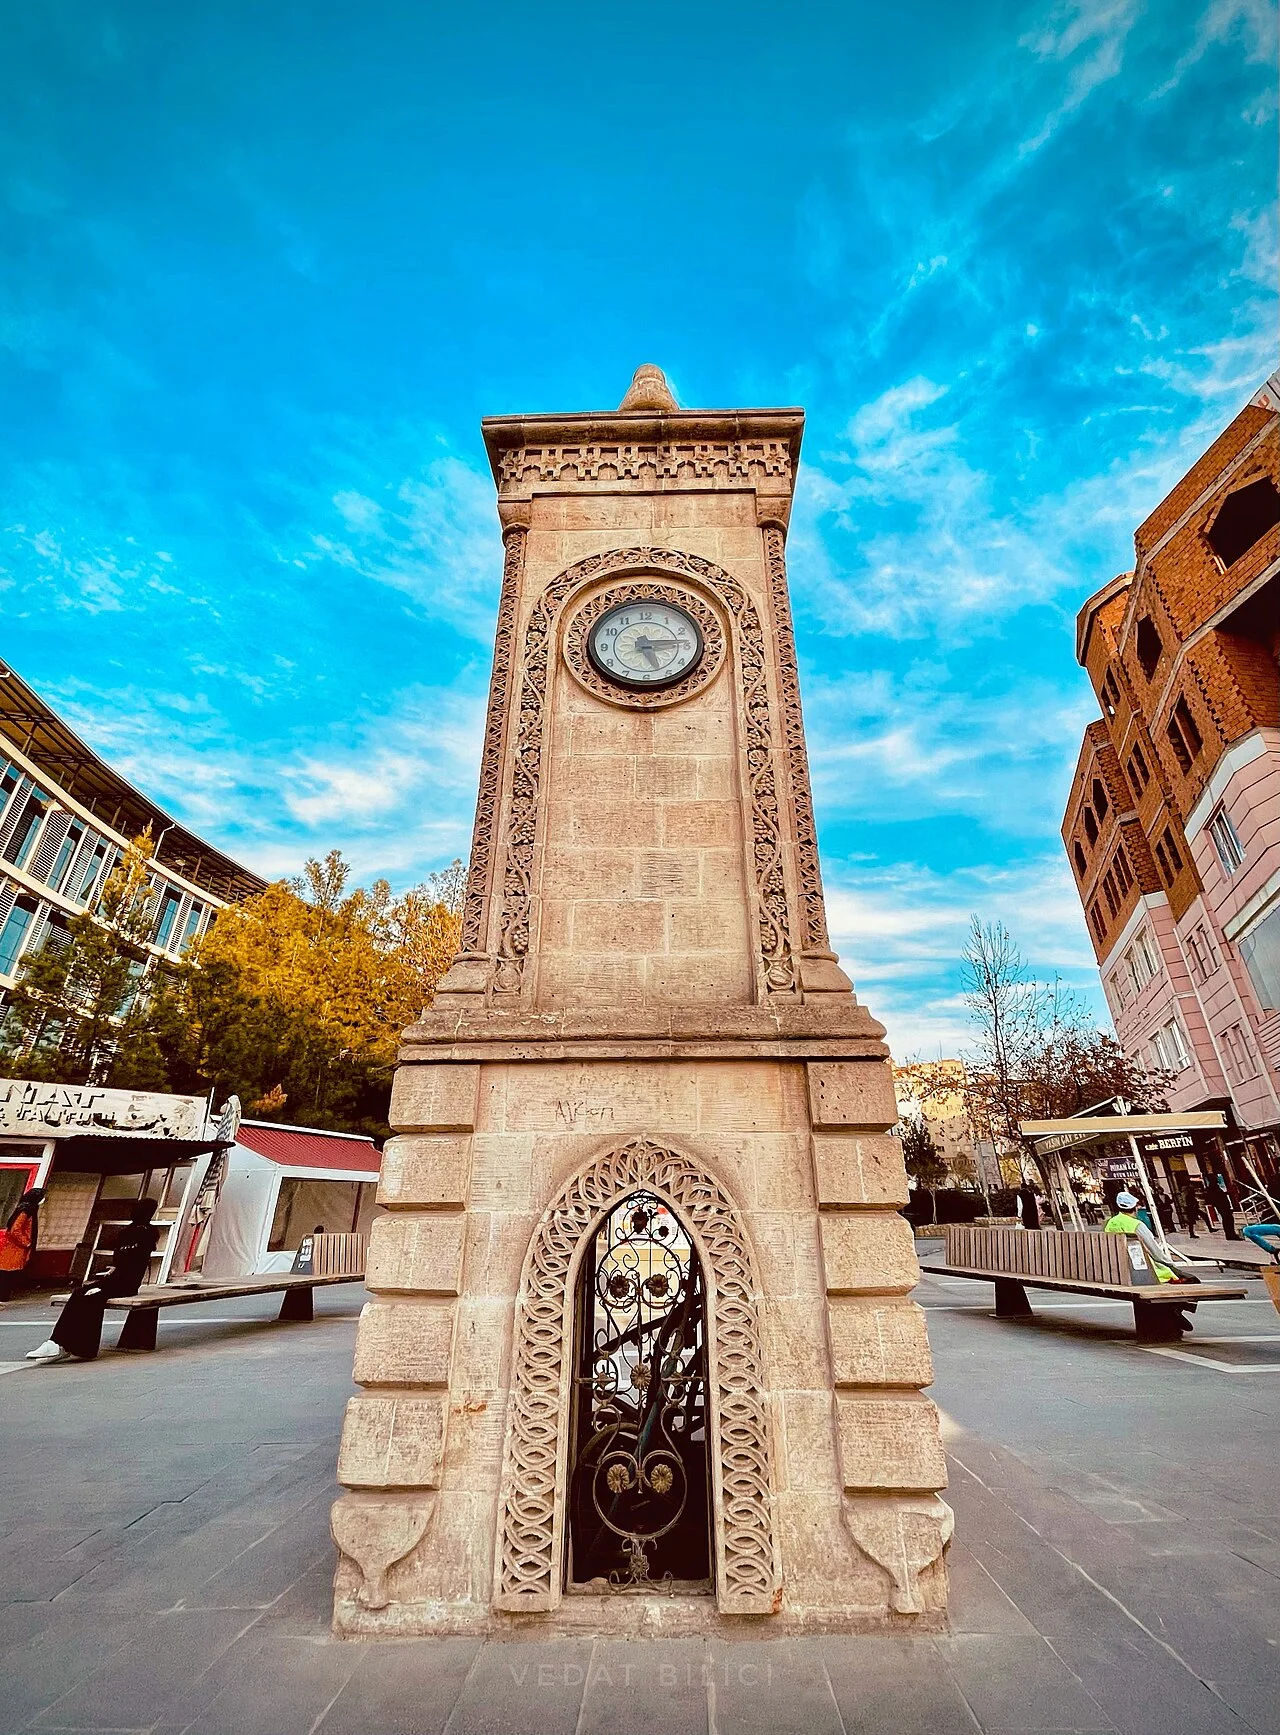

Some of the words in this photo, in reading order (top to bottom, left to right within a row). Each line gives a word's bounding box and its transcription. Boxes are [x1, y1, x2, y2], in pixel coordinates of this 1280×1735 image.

[639, 612, 652, 621] 12
[620, 617, 630, 625] 11
[605, 628, 617, 636] 10
[678, 627, 686, 635] 2
[600, 643, 608, 651] 9
[683, 641, 691, 650] 3
[606, 659, 614, 667] 8
[678, 657, 685, 666] 4
[621, 670, 630, 678] 7
[1157, 1135, 1194, 1149] BERFİN
